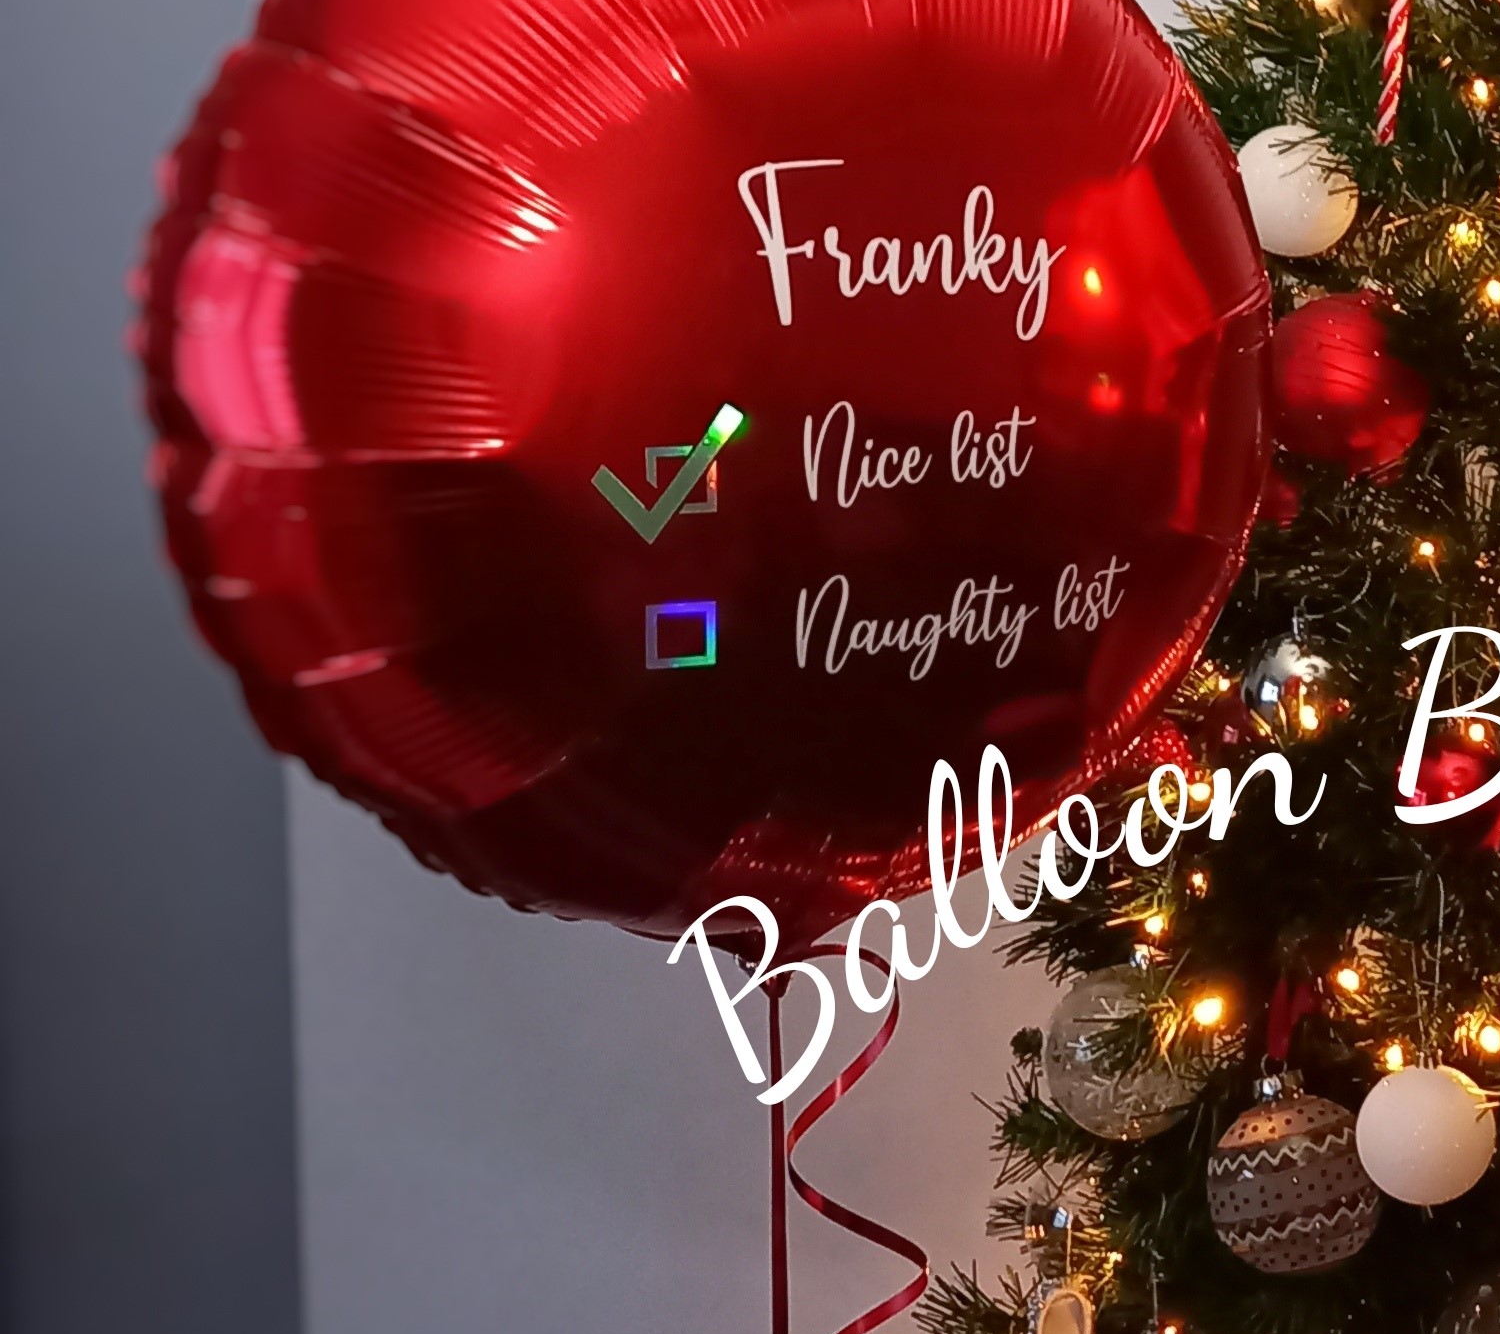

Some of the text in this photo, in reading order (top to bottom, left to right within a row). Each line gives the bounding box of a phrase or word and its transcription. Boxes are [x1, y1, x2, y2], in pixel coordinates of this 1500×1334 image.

[737, 159, 1067, 341] Franky
[803, 400, 1037, 509] Nice list
[796, 555, 1131, 681] Naughty list
